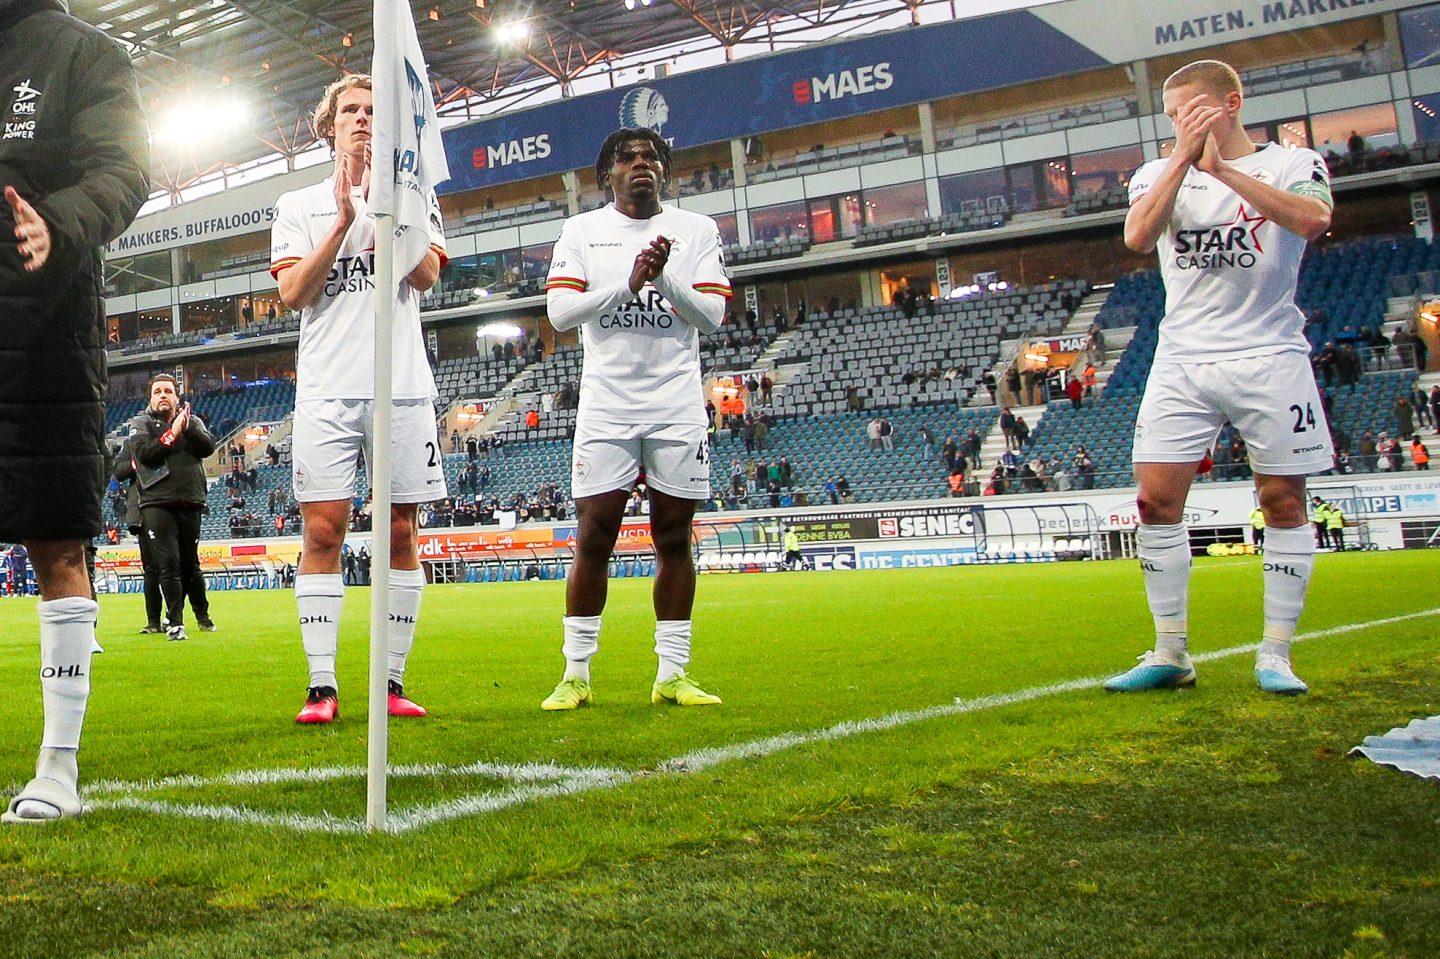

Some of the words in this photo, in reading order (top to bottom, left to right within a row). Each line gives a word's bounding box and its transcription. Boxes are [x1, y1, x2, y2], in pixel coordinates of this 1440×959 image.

[1154, 9, 1255, 46] MATEN.
[811, 62, 893, 103] MAES
[13, 102, 36, 113] OHL
[3, 130, 34, 140] POWER
[5, 120, 36, 133] KING
[487, 133, 552, 169] MAES
[118, 226, 183, 251] MAKKERS.
[1174, 227, 1247, 253] STAR
[1176, 252, 1257, 270] CASINO
[599, 313, 673, 329] CASINO
[1289, 402, 1315, 433] 24
[900, 513, 974, 537] SENEC
[1263, 563, 1301, 578] OHL
[42, 664, 85, 679] OHL
